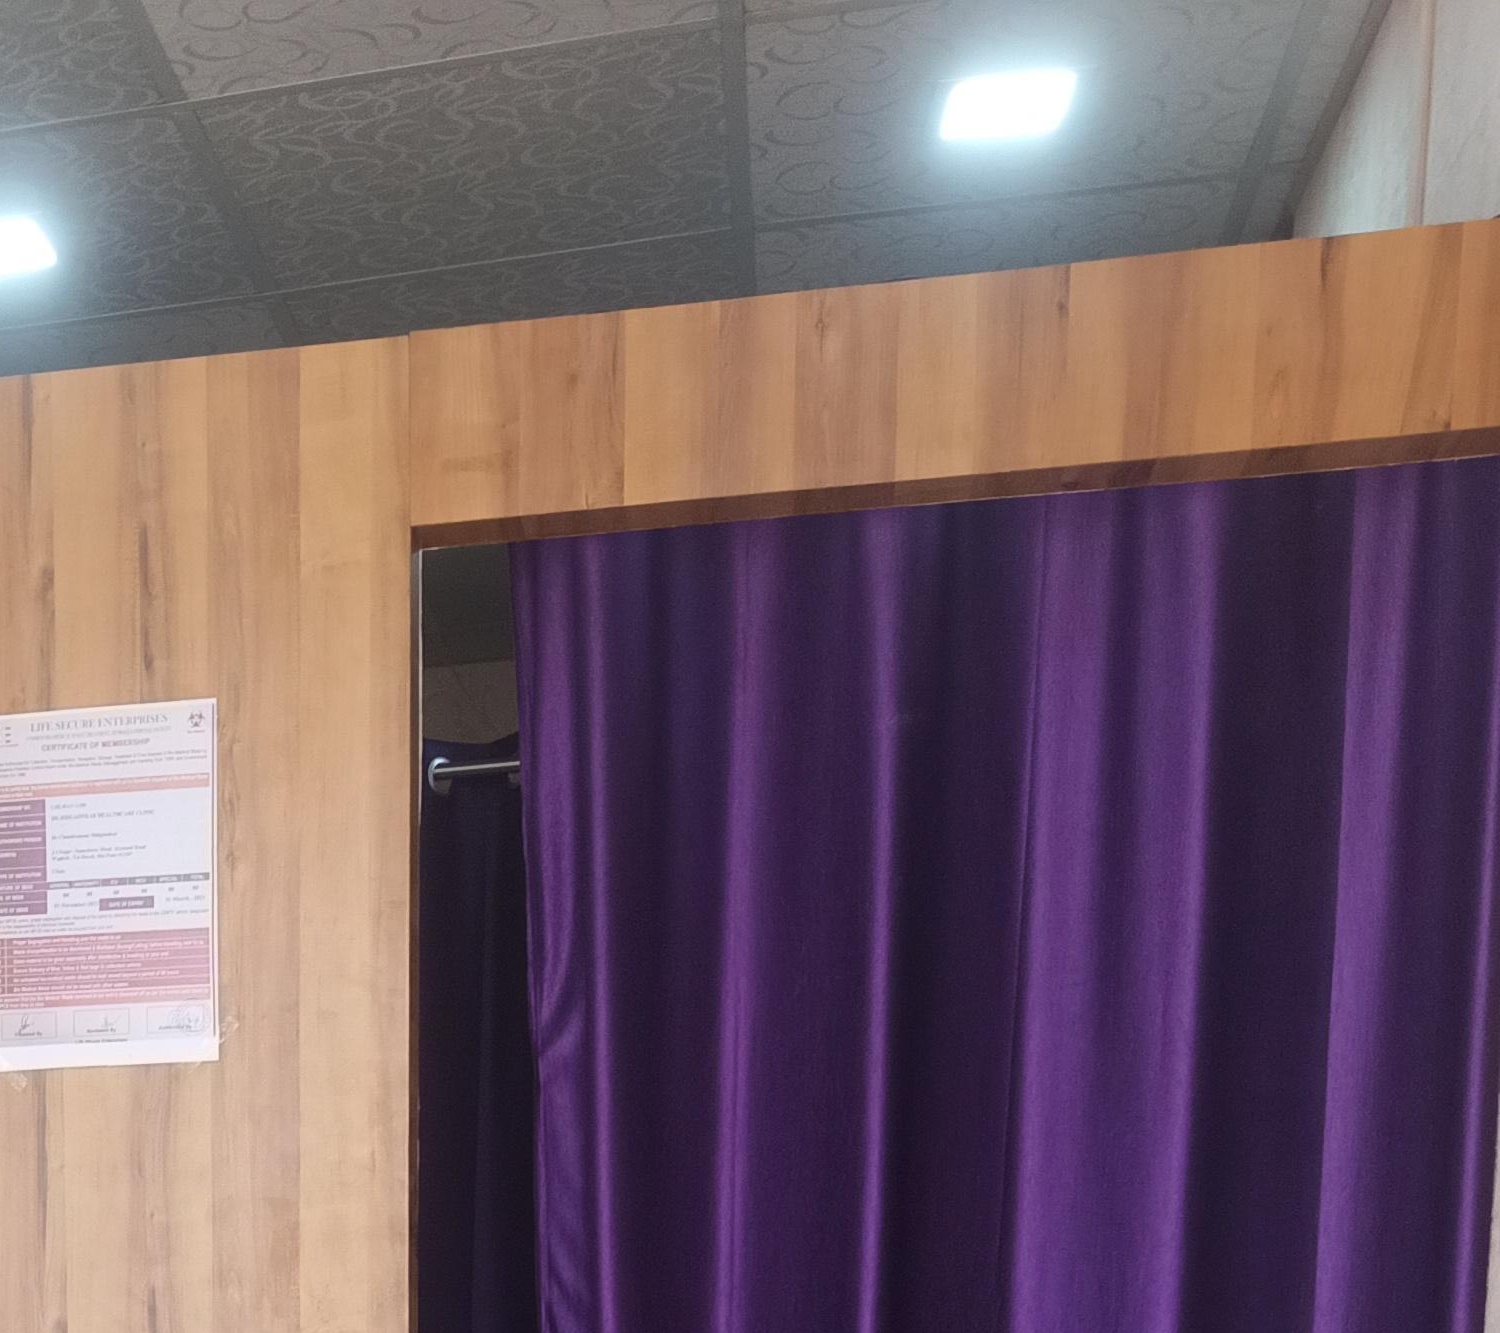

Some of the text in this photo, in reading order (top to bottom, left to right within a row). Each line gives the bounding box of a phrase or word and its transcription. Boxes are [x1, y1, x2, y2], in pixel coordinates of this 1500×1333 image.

[30, 713, 169, 733] LIFE SECURE ENTERPRISES
[41, 737, 151, 752] CERTIFICATE OF MEMBERSHIP
